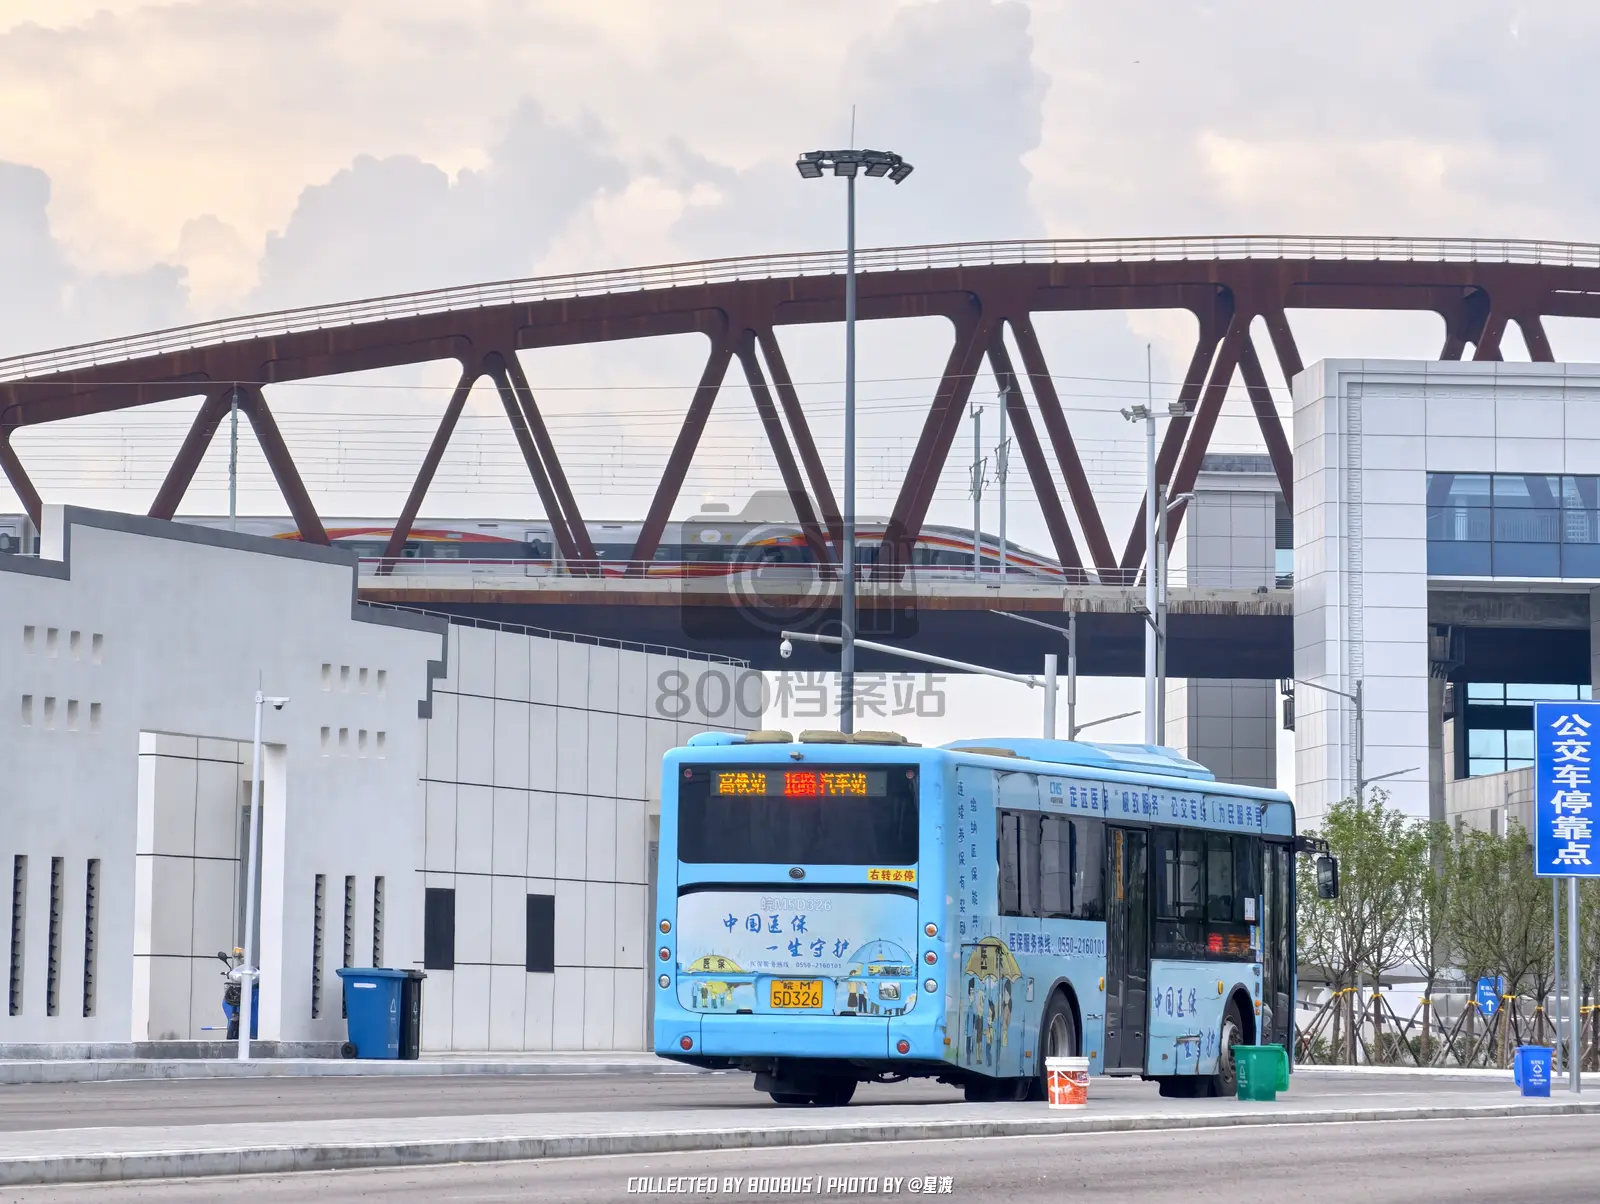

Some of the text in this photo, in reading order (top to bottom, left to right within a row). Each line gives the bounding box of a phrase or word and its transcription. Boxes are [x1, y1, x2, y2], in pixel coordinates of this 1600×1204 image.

[718, 772, 766, 794] 高铁站
[819, 772, 866, 794] 汽车站
[1550, 713, 1593, 865] 公交车停靠点
[870, 869, 914, 881] 右转必停
[760, 897, 832, 912] 皖M5D326
[723, 913, 809, 934] 中国医保
[766, 938, 849, 958] 一生守护
[703, 958, 725, 969] 医保
[796, 961, 842, 969] 0550-2160101
[773, 991, 820, 1006] 5D326
[1155, 986, 1197, 1018] 中国医保
